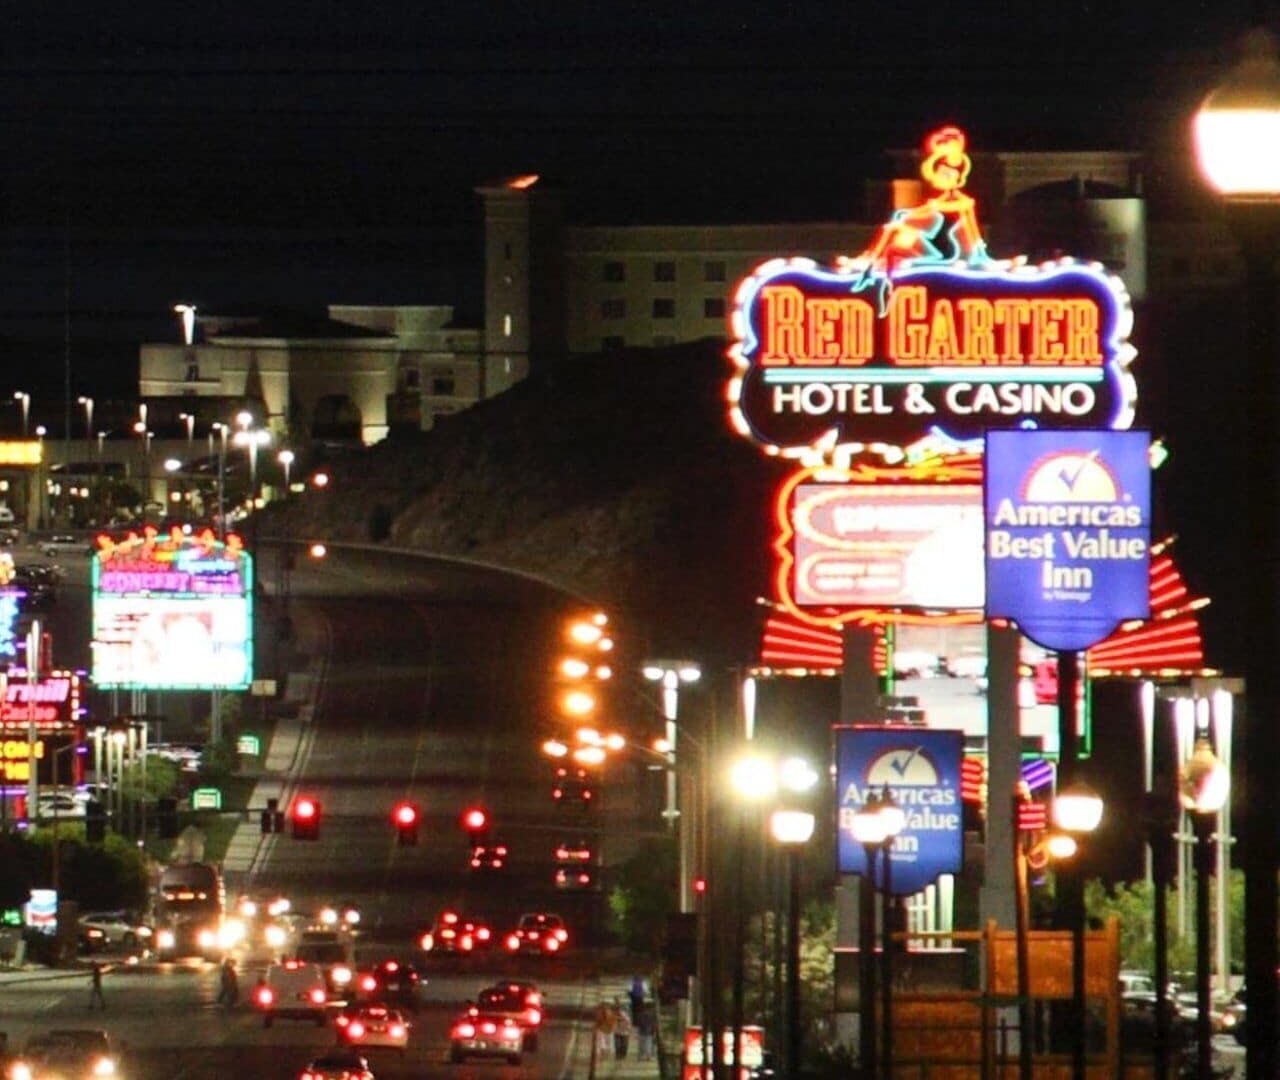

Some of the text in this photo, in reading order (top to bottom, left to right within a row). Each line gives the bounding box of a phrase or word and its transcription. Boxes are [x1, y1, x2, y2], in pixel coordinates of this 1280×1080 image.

[761, 286, 1104, 366] RED GARTER
[773, 383, 1096, 416] HOTEL & CASINO
[994, 497, 1142, 527] Americas
[990, 528, 1147, 560] Best Value
[1042, 560, 1093, 589] Inn
